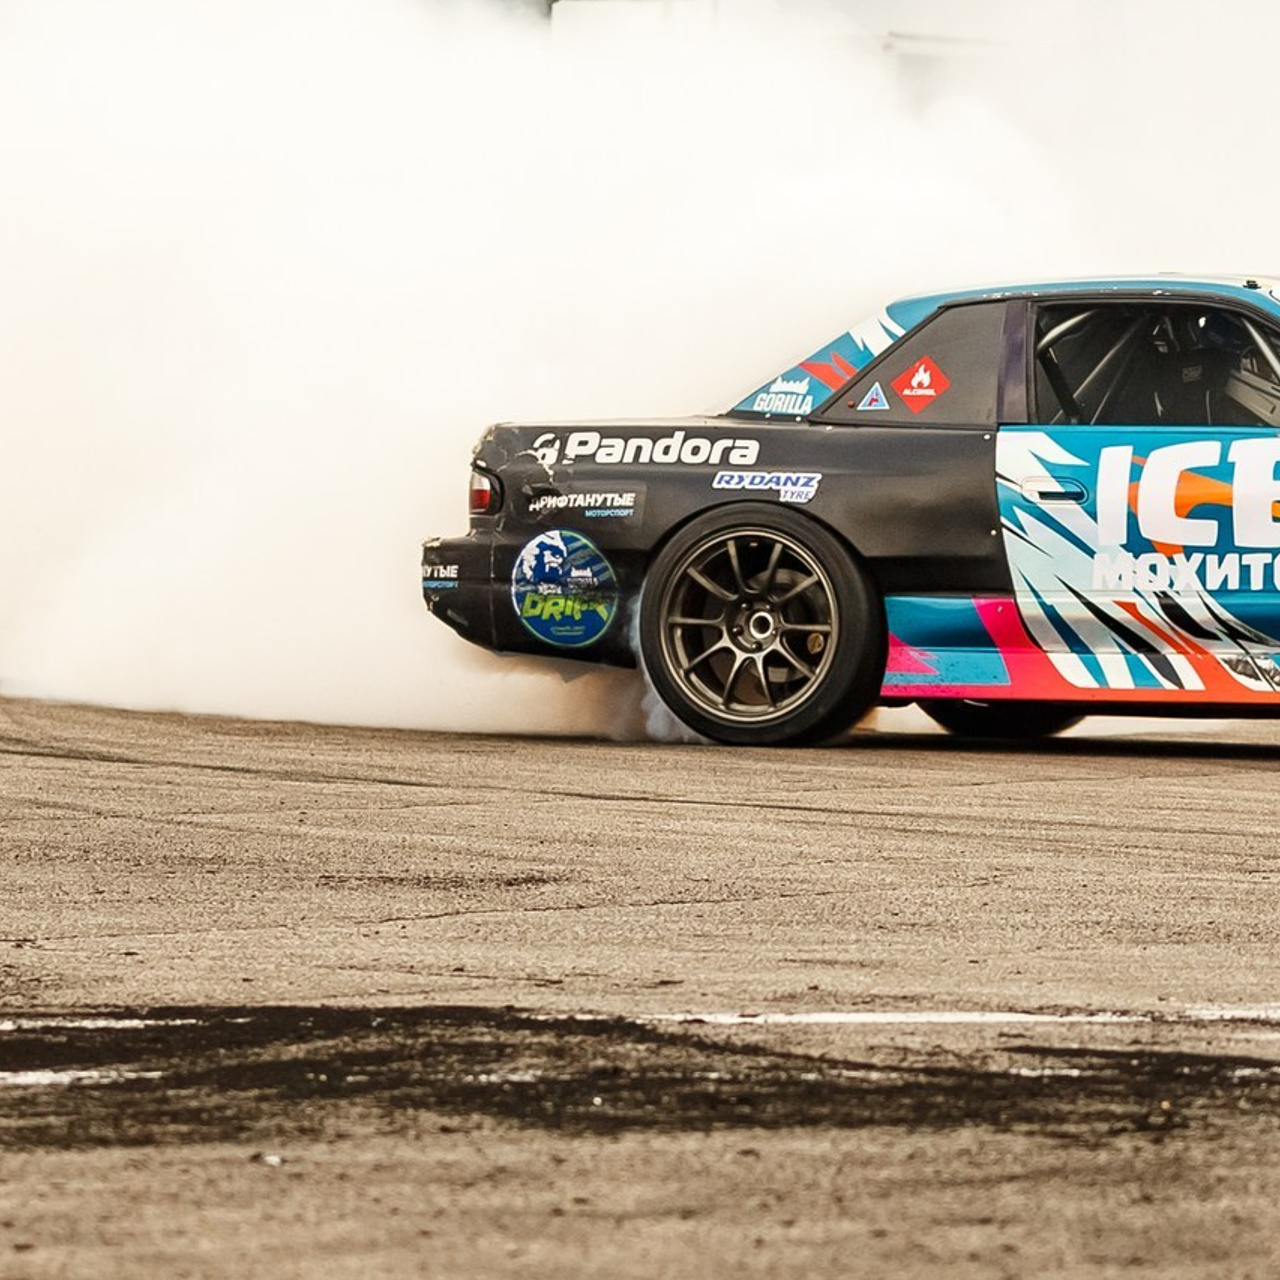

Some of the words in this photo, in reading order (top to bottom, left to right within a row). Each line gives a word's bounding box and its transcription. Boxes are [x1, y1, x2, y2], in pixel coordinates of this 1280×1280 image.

[753, 393, 814, 415] GORILLA
[562, 430, 761, 465] Pandora
[715, 473, 819, 488] RYDANZ
[528, 492, 636, 511] ДРИФТАНУТЫЕ
[781, 489, 813, 500] TYRE
